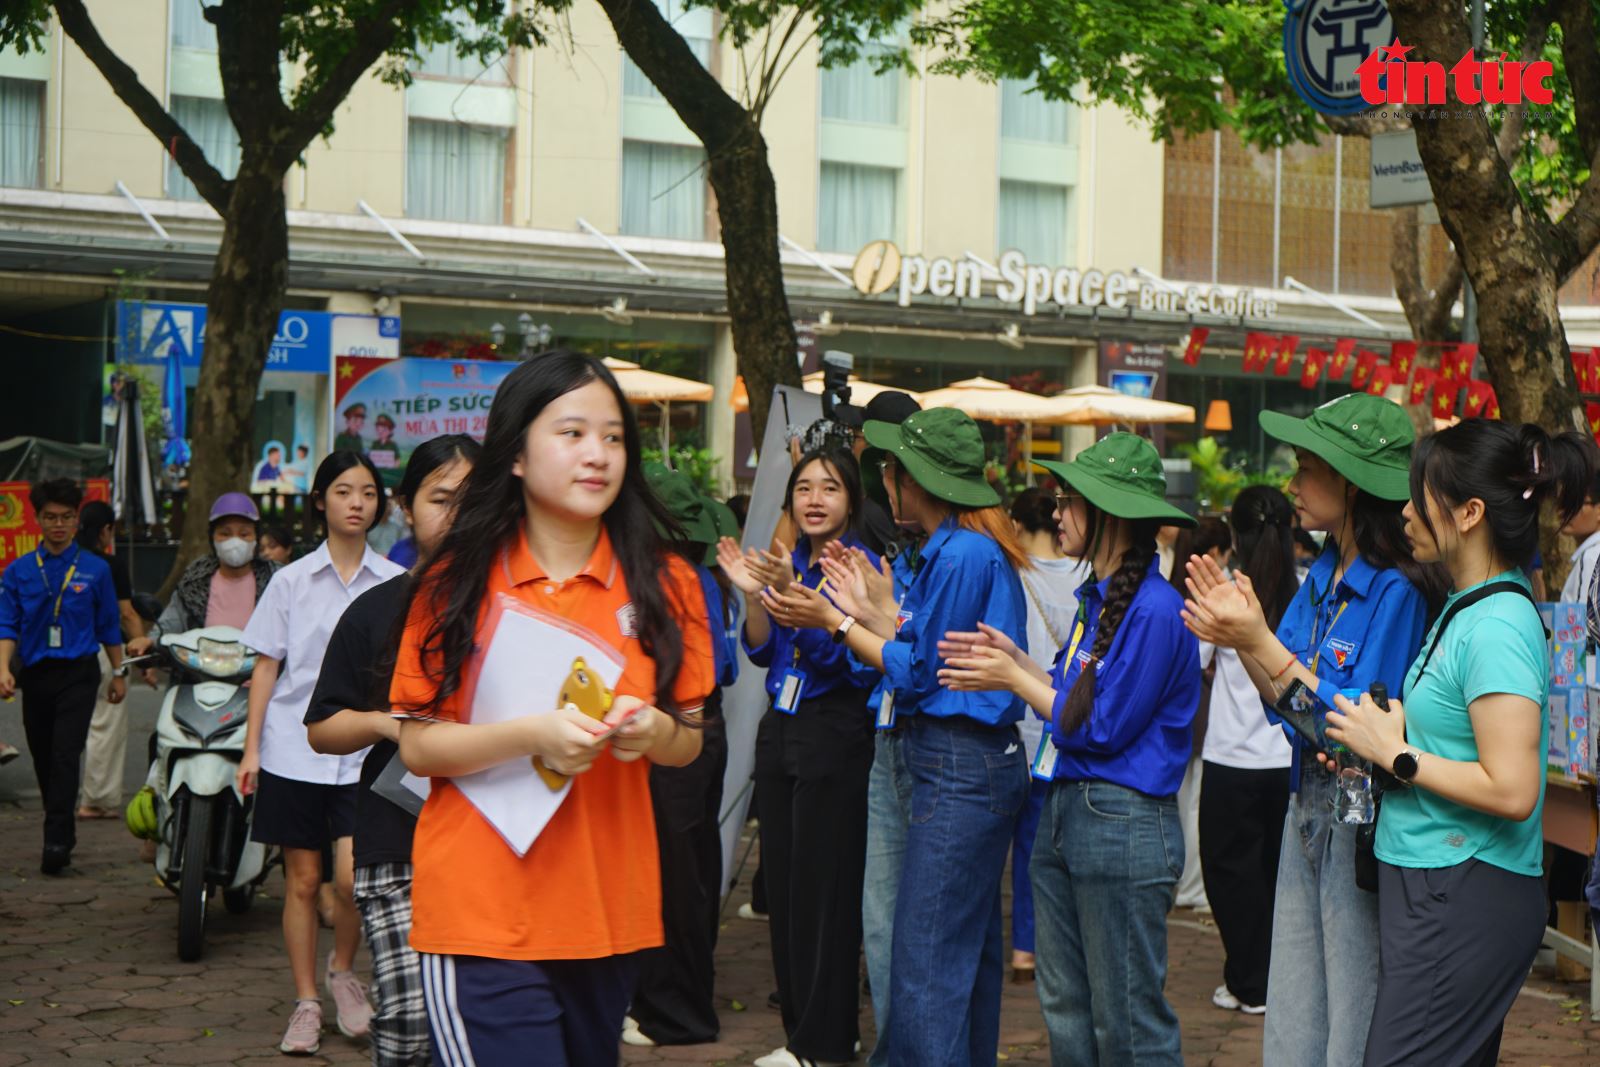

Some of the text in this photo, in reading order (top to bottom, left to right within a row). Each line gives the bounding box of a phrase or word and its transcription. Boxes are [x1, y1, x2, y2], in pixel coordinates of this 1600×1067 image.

[1373, 160, 1425, 176] VietinBan
[997, 249, 1128, 315] Space
[1140, 283, 1180, 312] Bar
[1208, 287, 1277, 319] Coffee
[443, 416, 468, 433] THI
